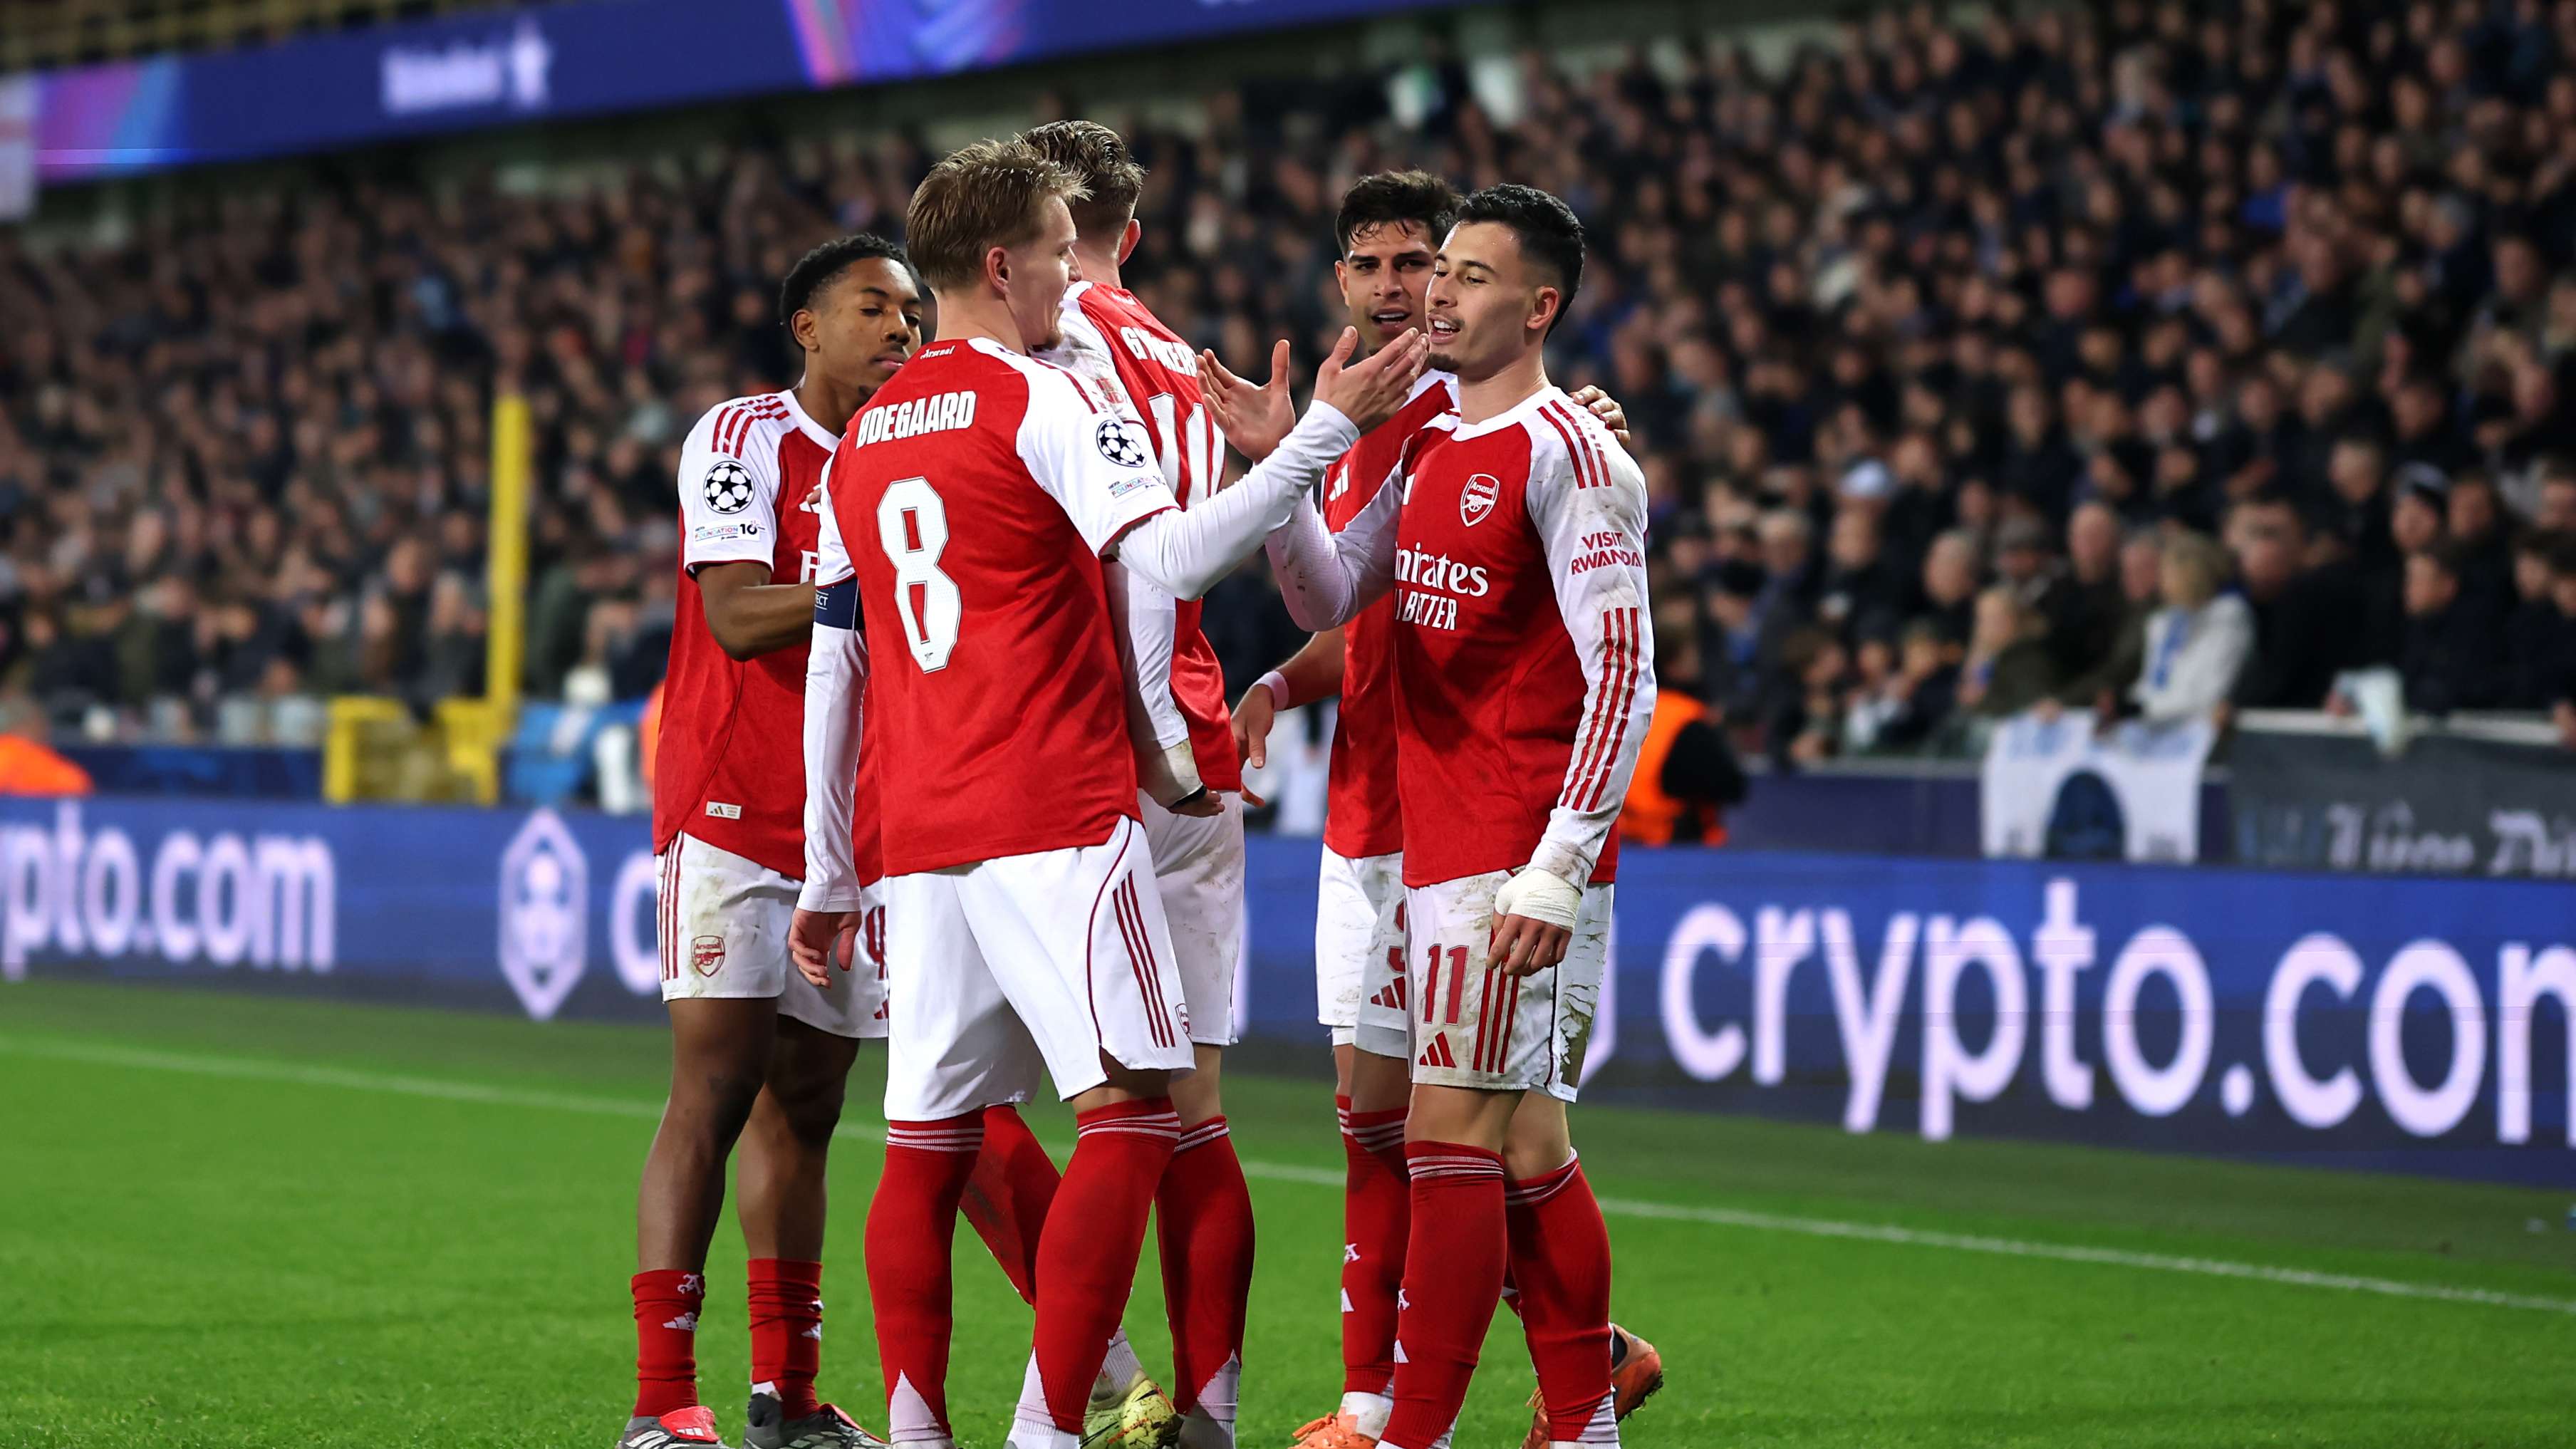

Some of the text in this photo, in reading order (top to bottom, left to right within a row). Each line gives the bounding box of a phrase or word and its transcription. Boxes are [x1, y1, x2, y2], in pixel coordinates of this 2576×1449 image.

[920, 345, 955, 360] Arsenal
[856, 390, 977, 450] ØDEGAARD
[1470, 481, 1495, 495] Arsenal
[1395, 541, 1489, 597] mirates
[1572, 549, 1642, 576] RWANDA
[1581, 531, 1623, 551] VISIT
[876, 476, 962, 674] 8
[0, 796, 335, 982] pto.com
[1424, 943, 1469, 1026] 11
